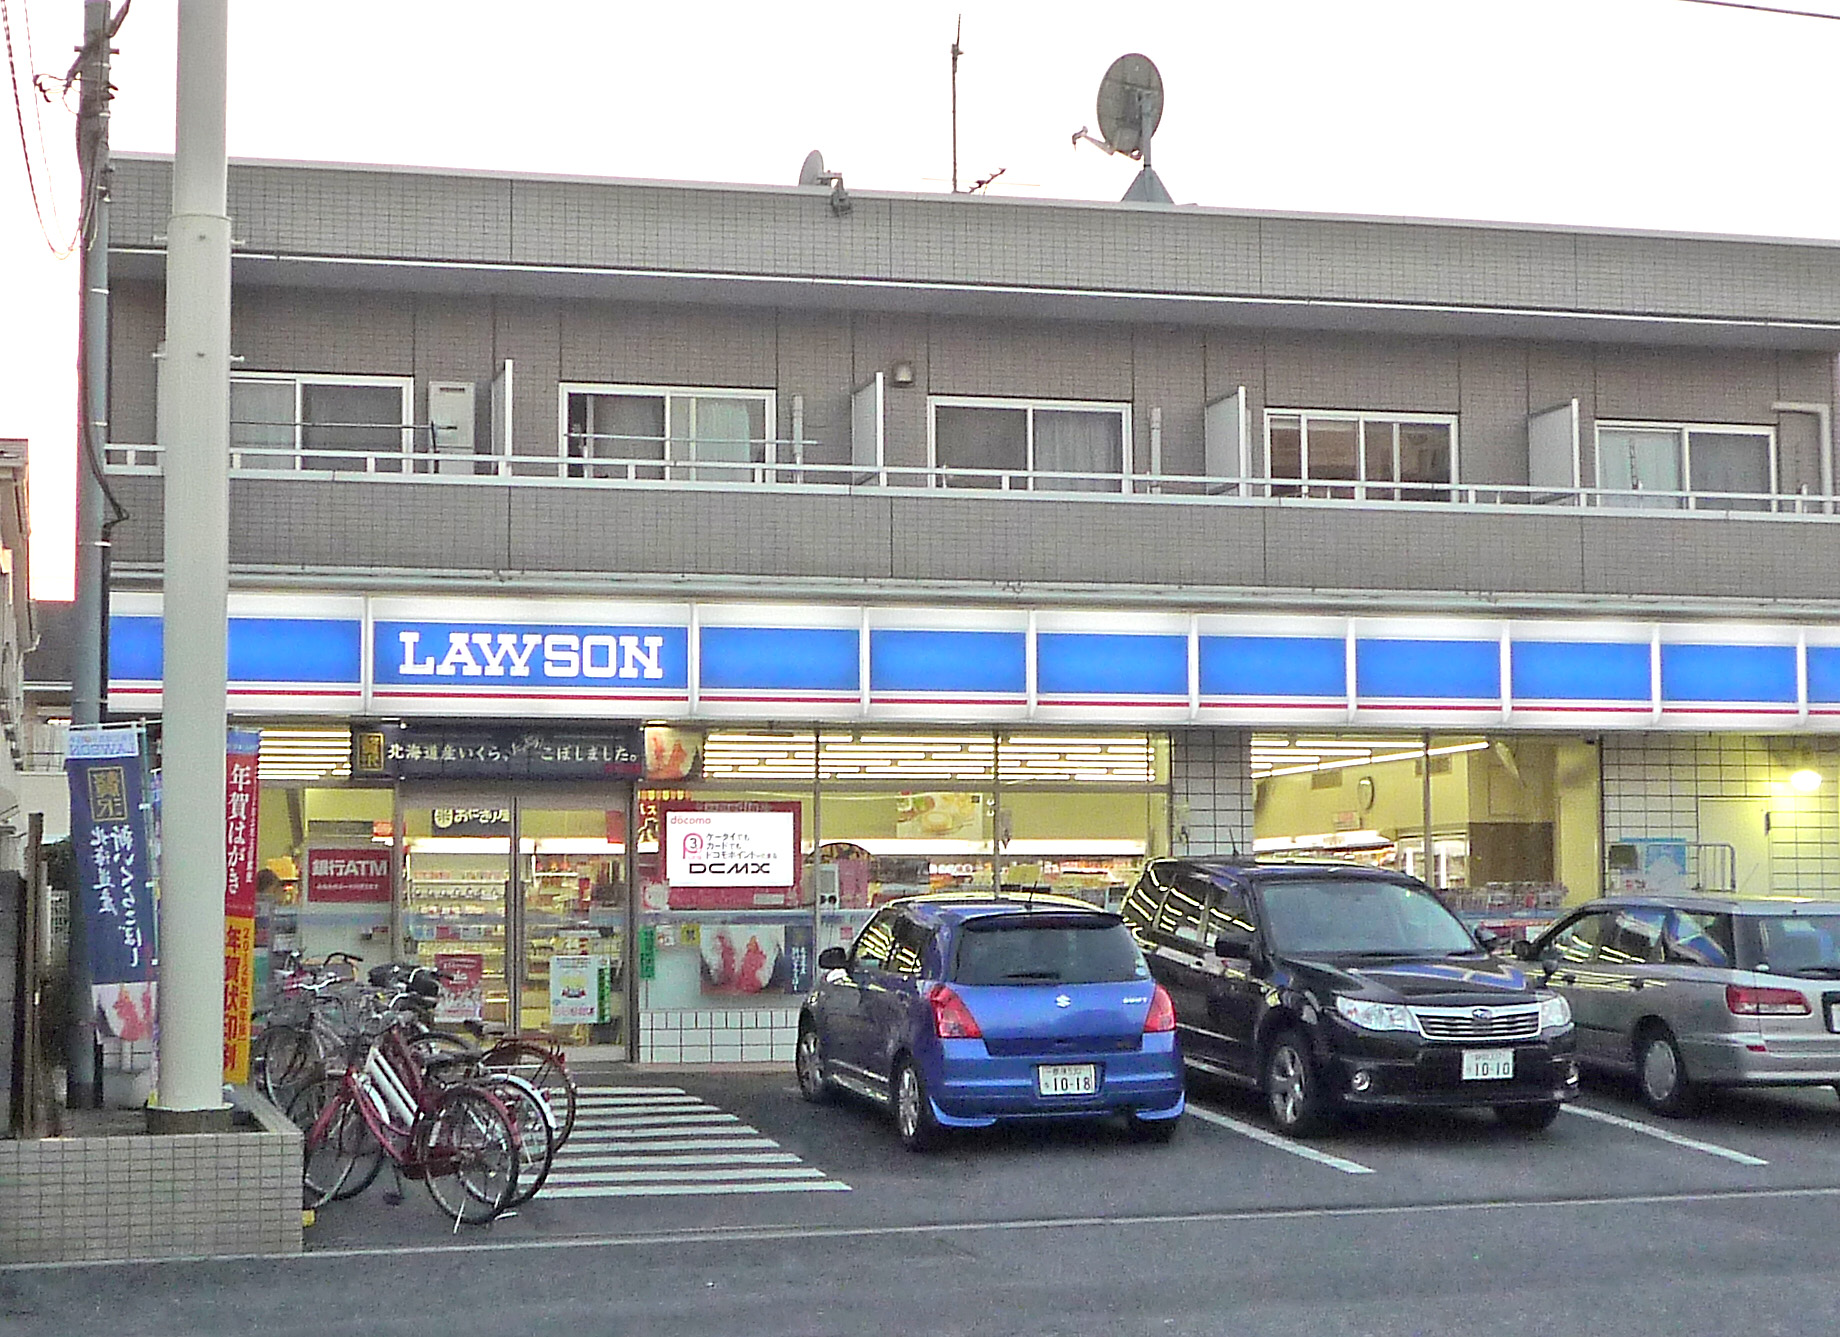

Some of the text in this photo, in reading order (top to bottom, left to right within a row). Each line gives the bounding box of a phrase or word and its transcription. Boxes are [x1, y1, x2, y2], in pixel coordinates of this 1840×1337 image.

[399, 631, 664, 679] LAWSON
[228, 763, 251, 894] 年賀はがき
[312, 859, 388, 876] 銀行ATM
[689, 863, 770, 874] DCMX
[1475, 1062, 1510, 1076] 10-10
[1053, 1077, 1091, 1091] 10-18
